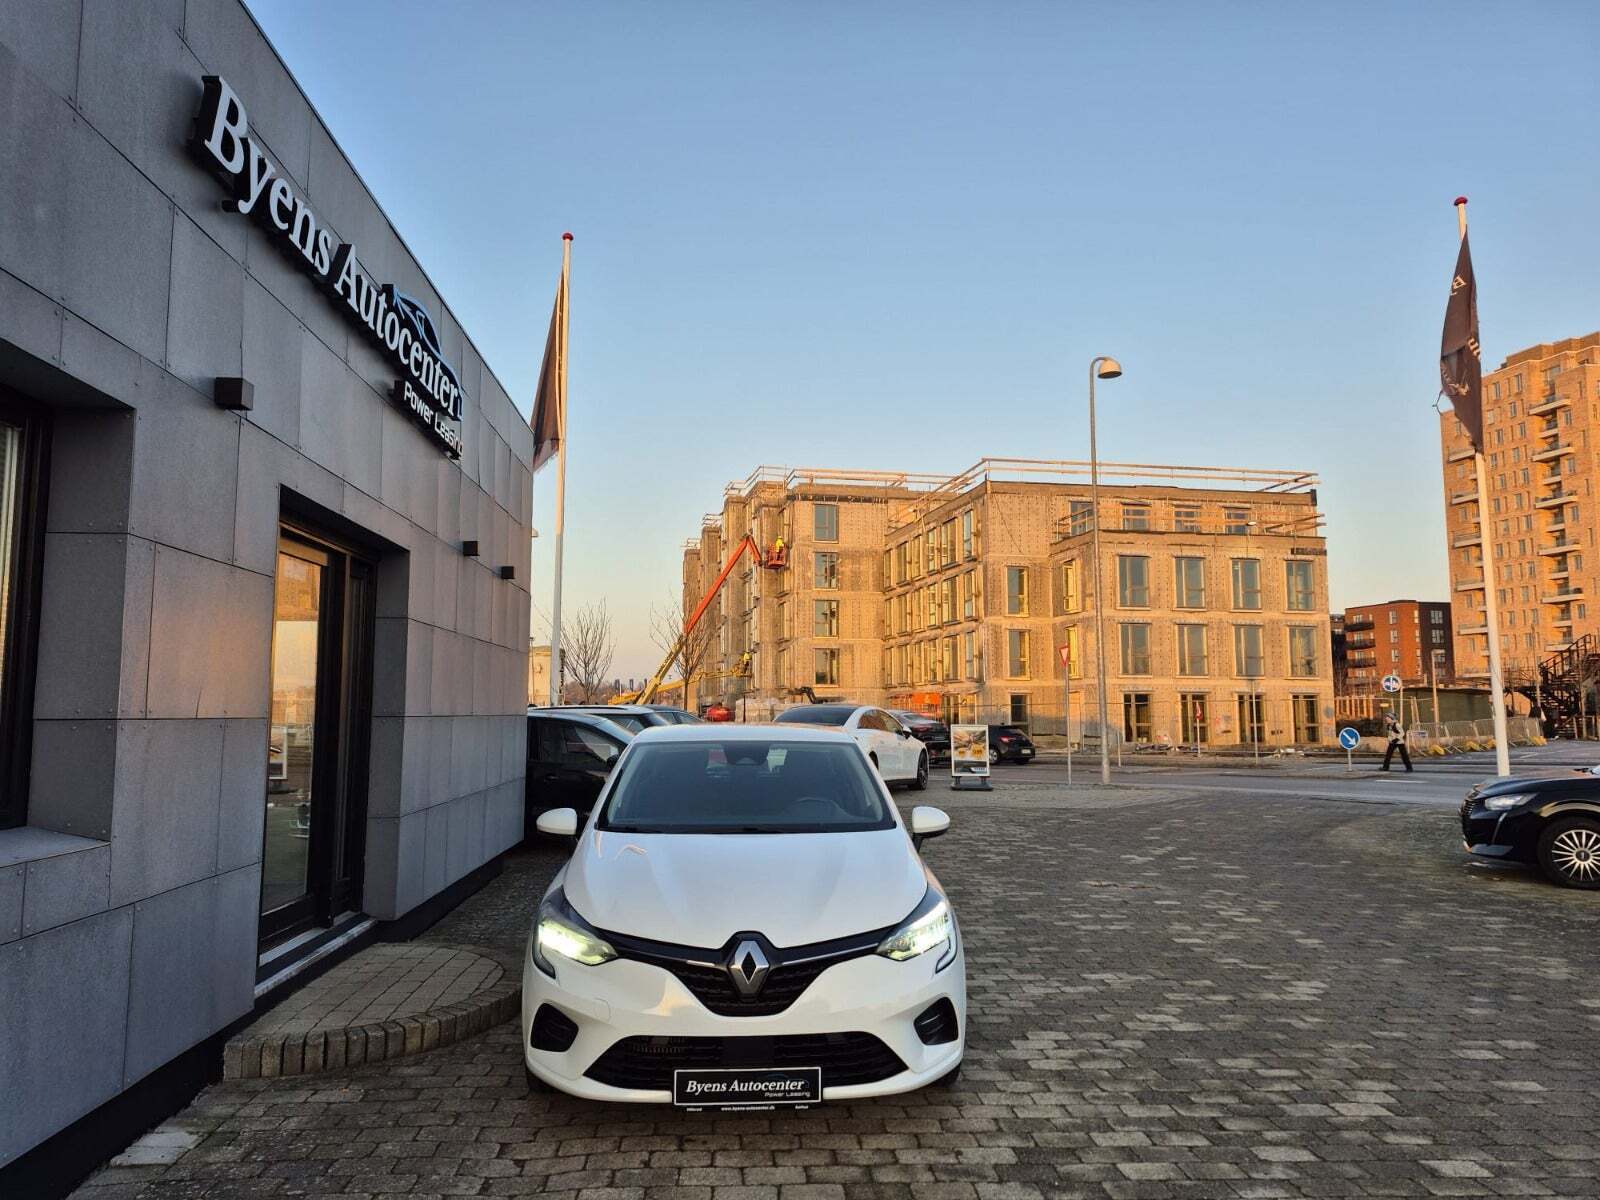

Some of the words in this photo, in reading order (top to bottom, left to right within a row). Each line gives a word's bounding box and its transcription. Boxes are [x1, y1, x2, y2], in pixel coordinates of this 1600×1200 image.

[203, 76, 332, 276] Byens
[334, 243, 459, 417] Autocenter
[403, 380, 434, 425] Power
[686, 1080, 727, 1095] Byens
[729, 1079, 805, 1092] Autocenter
